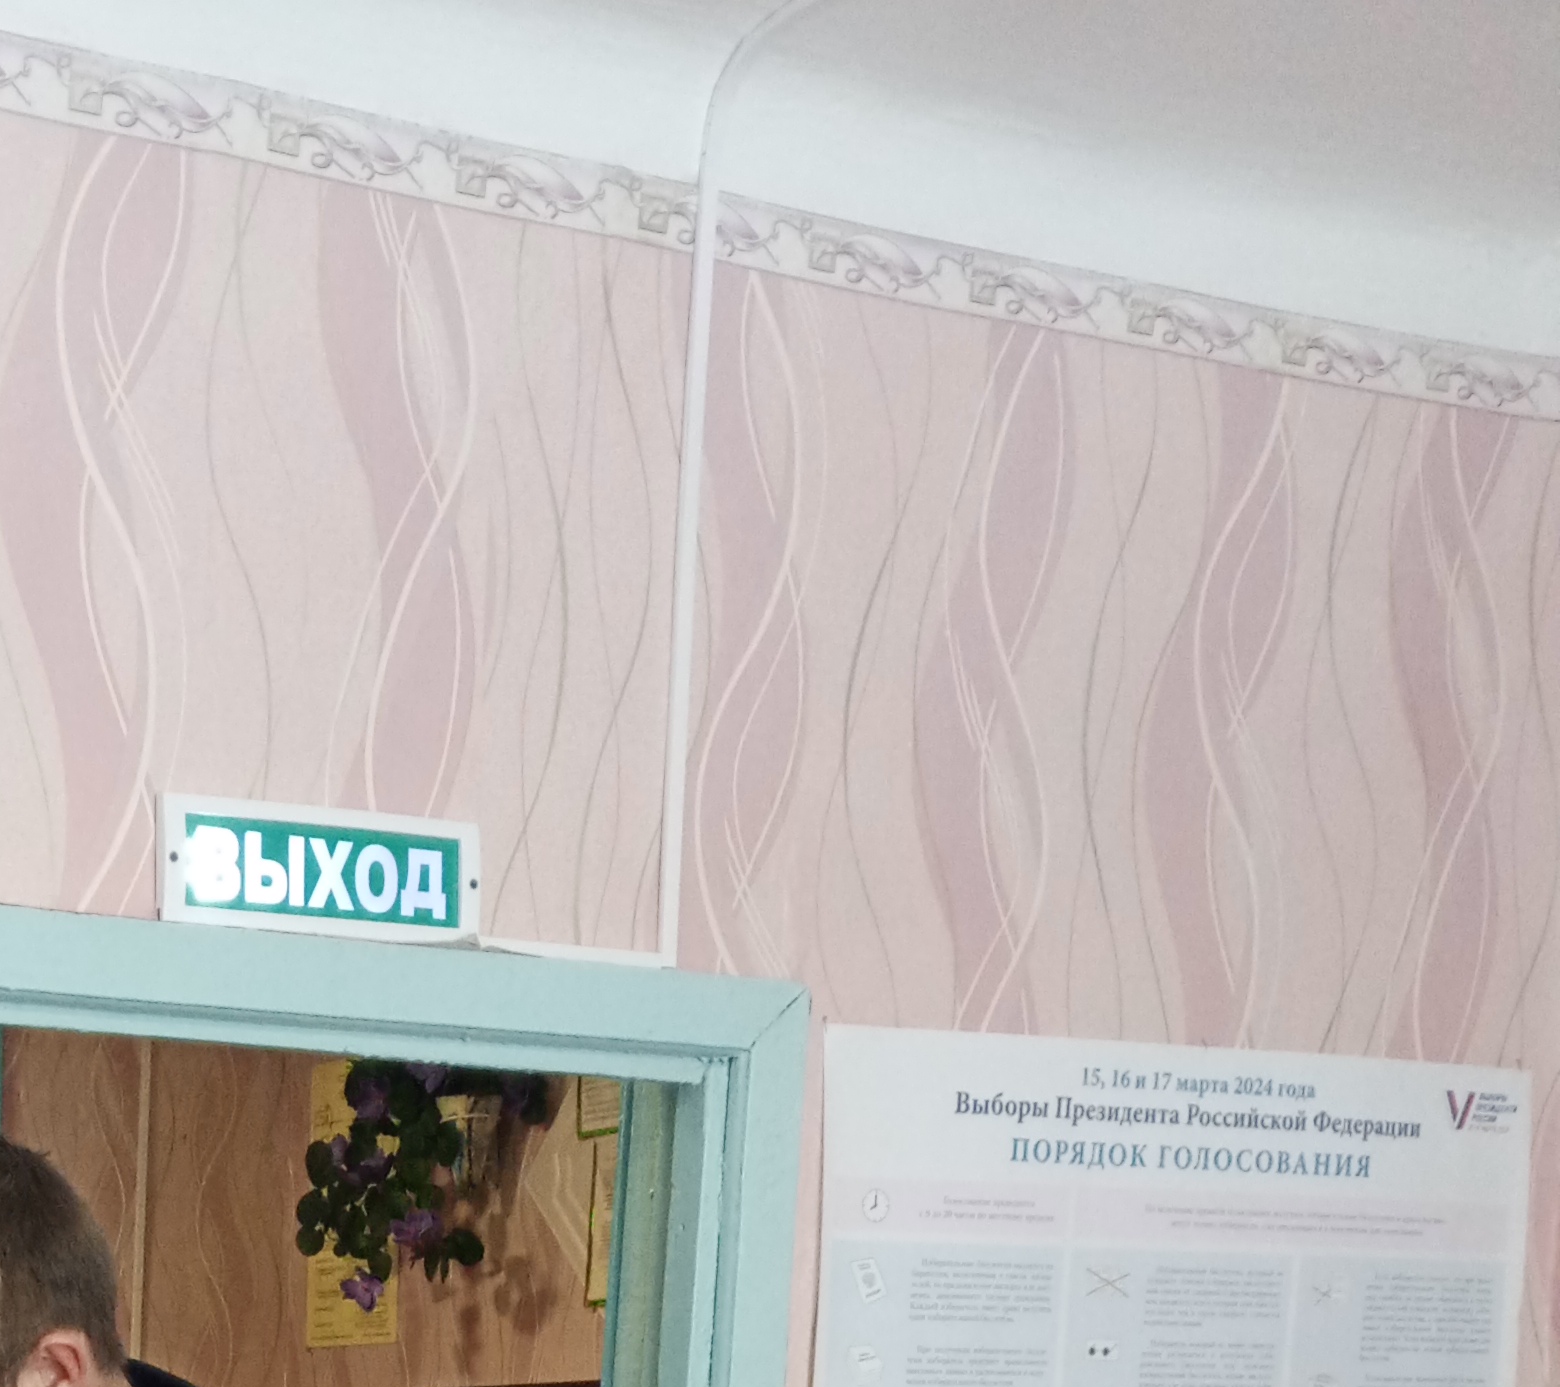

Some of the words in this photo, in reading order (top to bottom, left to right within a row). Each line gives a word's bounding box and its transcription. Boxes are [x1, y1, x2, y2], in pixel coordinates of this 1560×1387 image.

[186, 823, 447, 921] ВЫХОД
[1081, 1066, 1106, 1090] 15,
[1112, 1068, 1131, 1090] 16
[1134, 1074, 1147, 1091] и
[1153, 1071, 1173, 1092] 17
[1175, 1075, 1229, 1099] марта
[1233, 1076, 1274, 1098] 2024
[1277, 1081, 1317, 1102] года
[954, 1090, 1049, 1124] Выборы
[1055, 1096, 1181, 1128] Президента
[1186, 1102, 1308, 1133] Российской
[1312, 1110, 1423, 1143] Федерации
[1009, 1136, 1149, 1171] ПОРЯДОК
[1156, 1144, 1372, 1179] ГОЛОСОВАНИЯ
